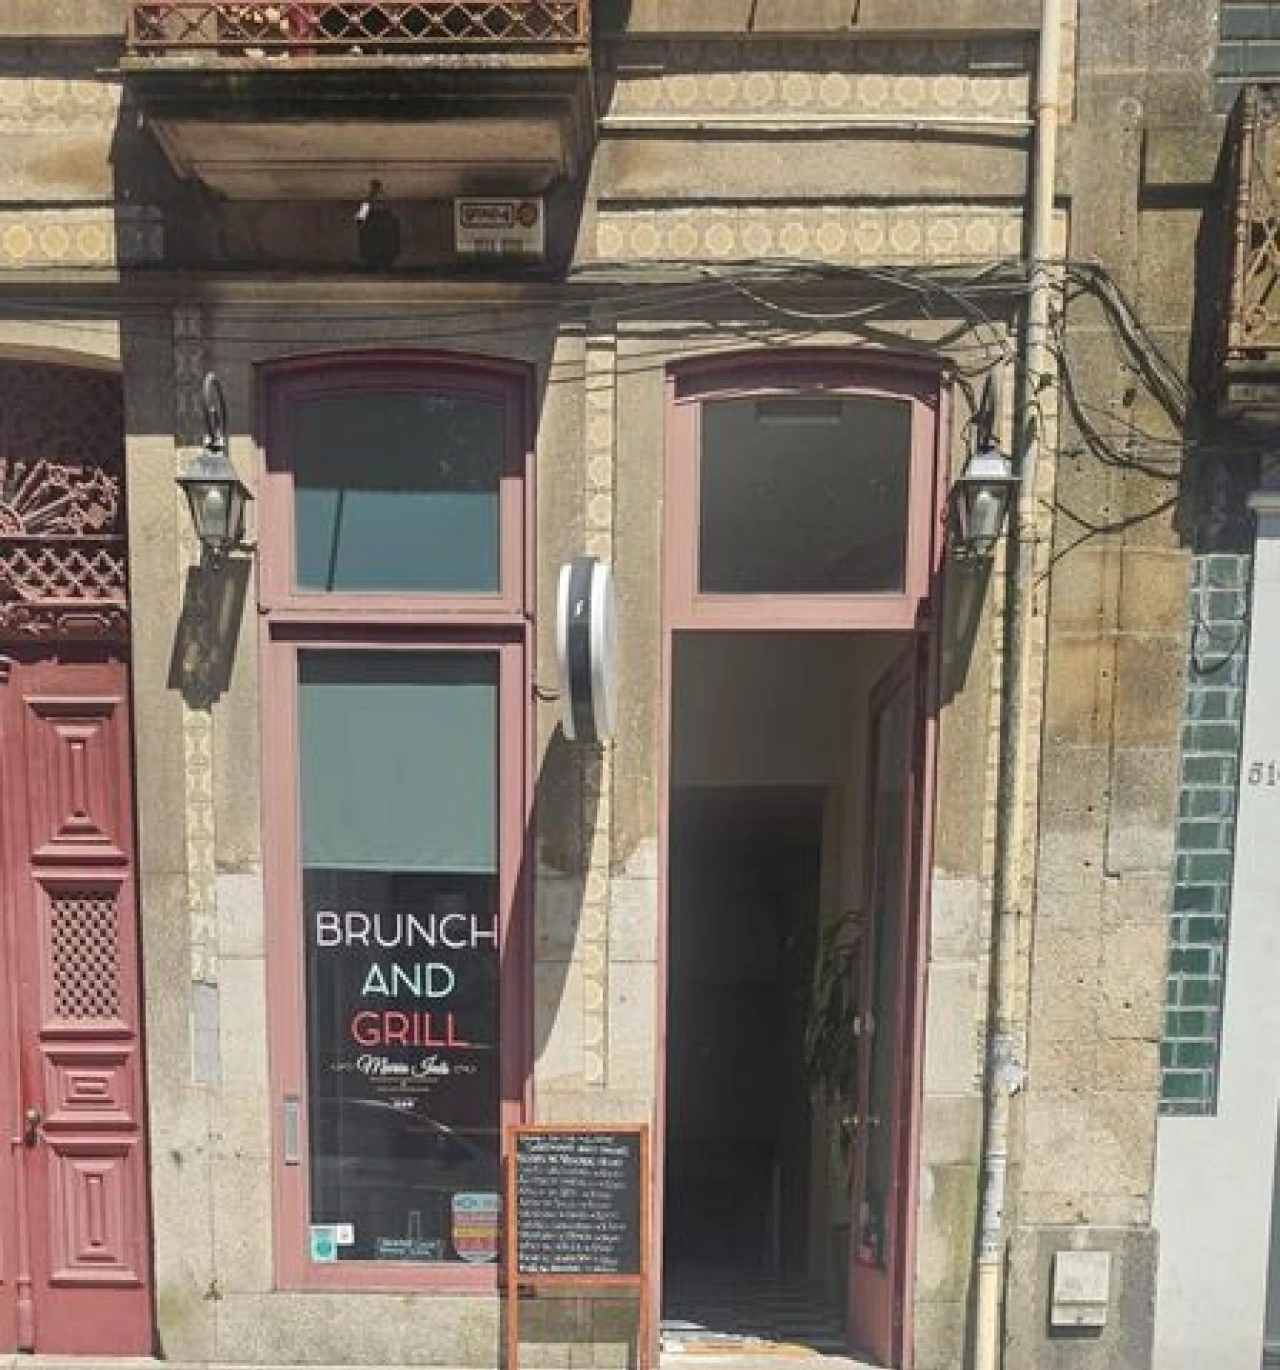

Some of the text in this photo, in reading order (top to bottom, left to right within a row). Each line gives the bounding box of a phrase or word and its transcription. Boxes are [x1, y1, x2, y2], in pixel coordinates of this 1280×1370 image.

[1248, 761, 1280, 786] 51
[316, 911, 498, 948] BRUNCH
[361, 962, 455, 998] AND
[350, 1011, 468, 1046] GRILL
